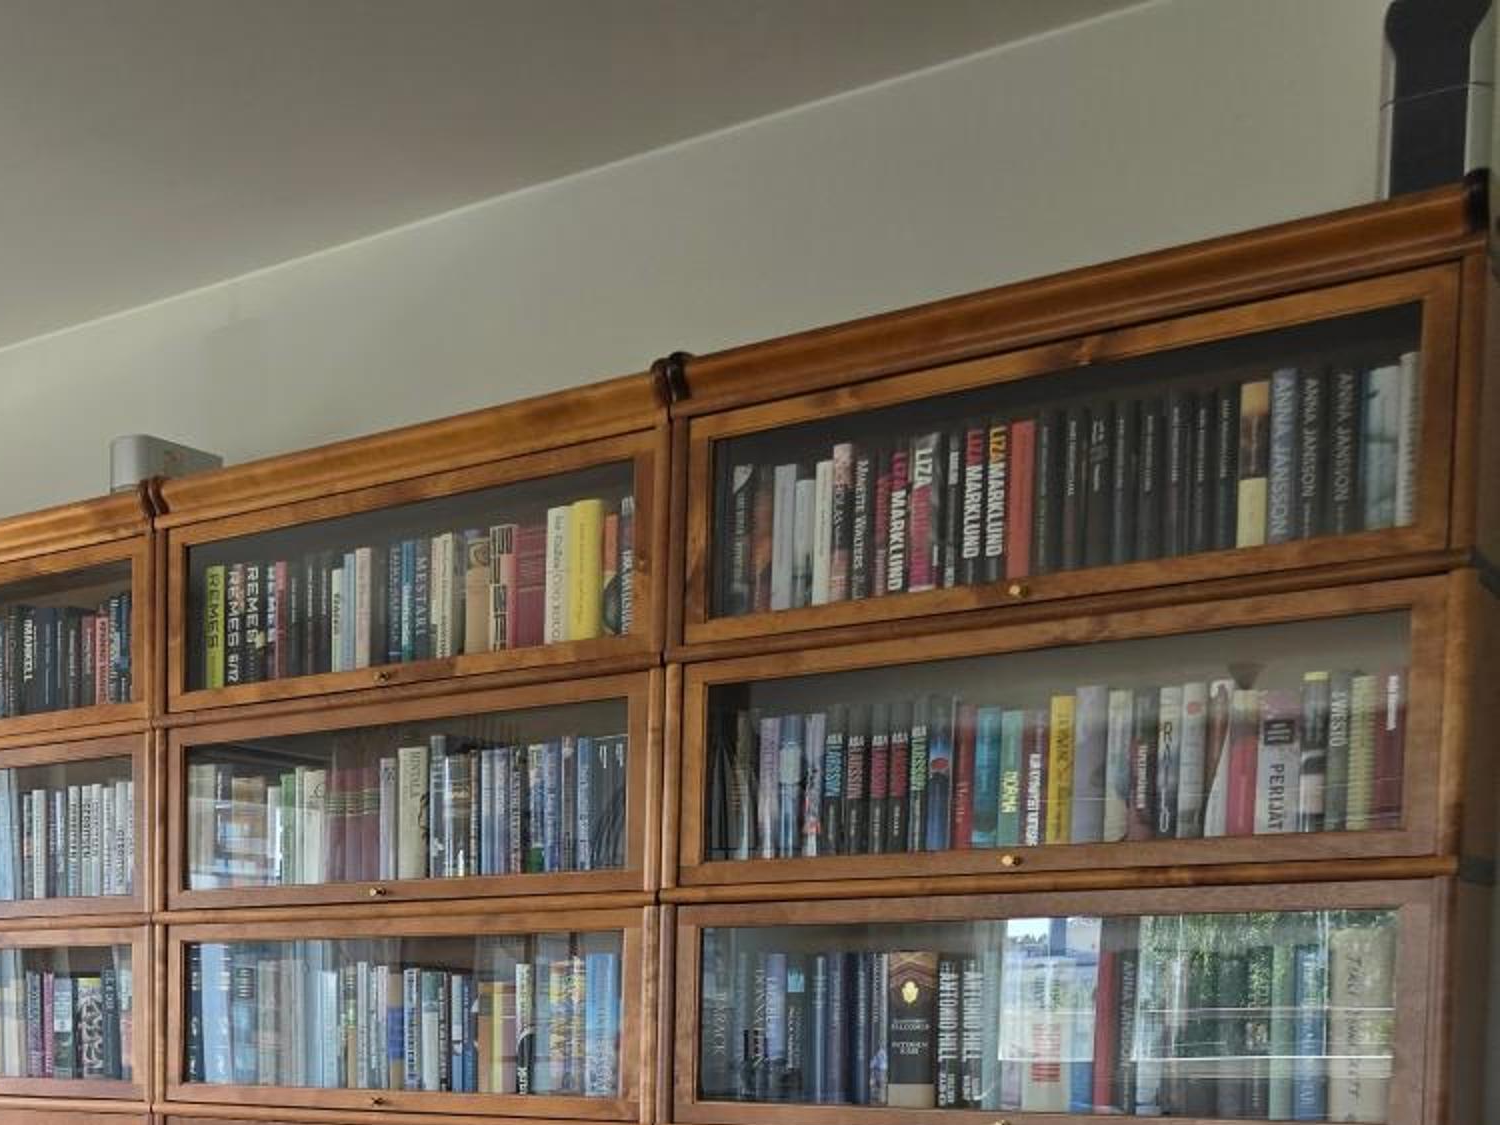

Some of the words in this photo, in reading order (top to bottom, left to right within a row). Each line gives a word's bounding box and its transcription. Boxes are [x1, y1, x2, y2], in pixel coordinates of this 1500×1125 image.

[1273, 379, 1295, 438] ANNA
[1303, 377, 1319, 426] ANNA
[1337, 372, 1354, 420] ANNA
[891, 451, 909, 488] LIZA
[912, 448, 934, 490] LIZA
[966, 432, 984, 466] LIZA
[989, 426, 1007, 464] LIZA
[1300, 427, 1316, 498] JANSSON
[1333, 425, 1350, 502] JANSSON
[962, 465, 983, 560] MARKLUND
[984, 463, 1006, 557] MARKLUND
[1270, 443, 1290, 538] JANSSON
[852, 514, 867, 570] WALTERS
[887, 488, 908, 592] MARKLUND
[206, 572, 221, 649] REMES
[227, 571, 239, 647] REMES
[246, 566, 259, 644] REMES
[938, 972, 959, 1030] ANTONIO
[962, 971, 982, 1030] ANTONIO
[938, 1031, 959, 1063] HILL
[962, 1030, 982, 1063] HILL
